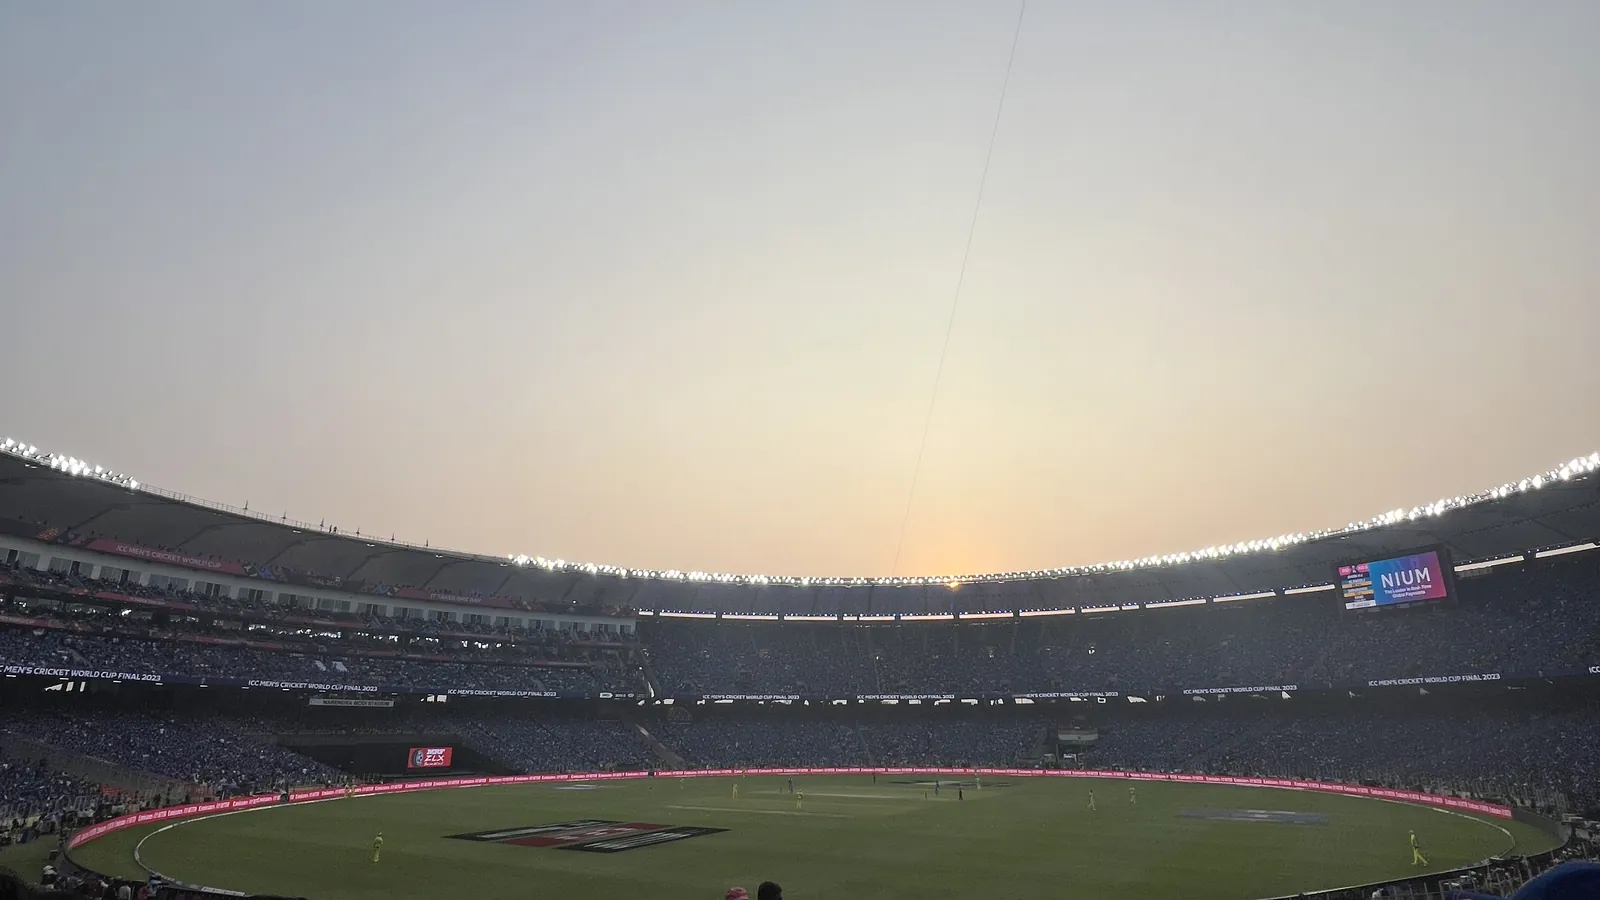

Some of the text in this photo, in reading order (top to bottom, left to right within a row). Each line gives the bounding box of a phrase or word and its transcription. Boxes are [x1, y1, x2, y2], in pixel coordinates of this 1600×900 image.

[1381, 567, 1430, 588] NIUM
[4, 665, 32, 674] MEN'S
[34, 667, 70, 676] CRICKET
[71, 670, 100, 678] WORLD
